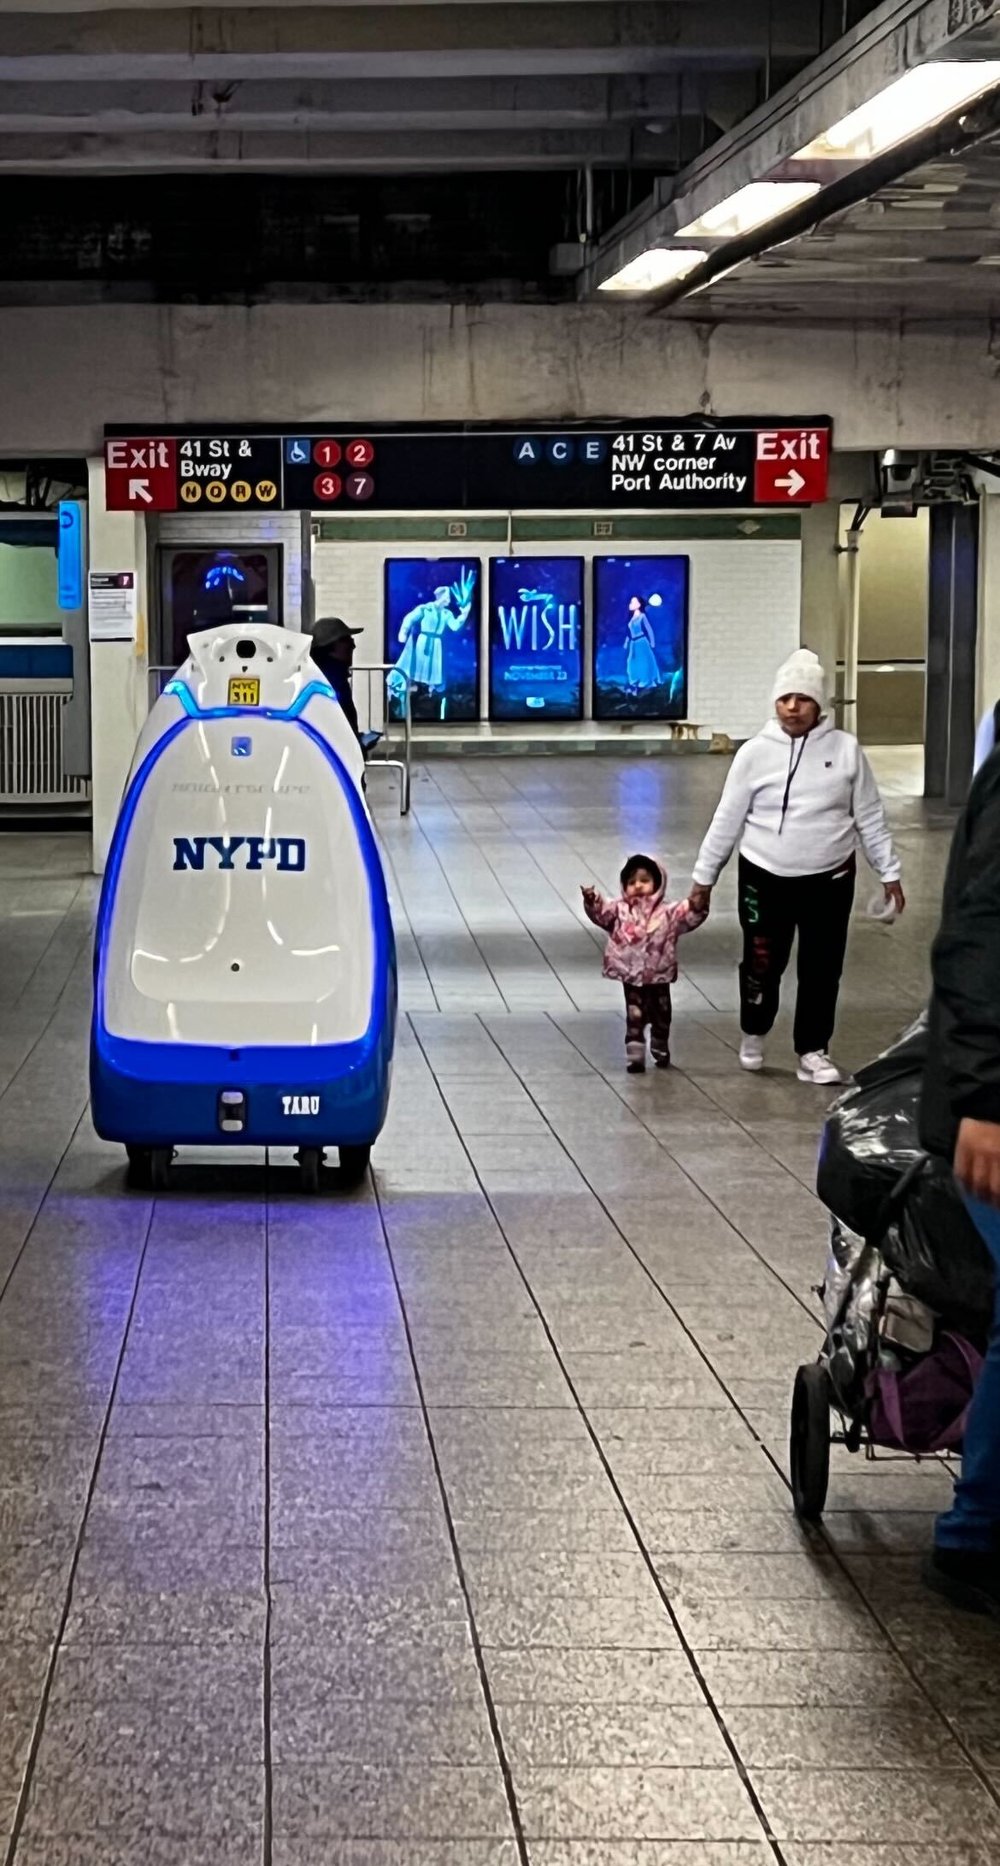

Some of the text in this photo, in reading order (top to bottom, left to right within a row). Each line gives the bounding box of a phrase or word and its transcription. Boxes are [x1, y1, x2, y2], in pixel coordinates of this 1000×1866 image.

[180, 440, 252, 457] 41 St &
[518, 441, 600, 459] A C E
[612, 433, 737, 451] 41 St & 7 Av
[756, 432, 821, 461] Exit
[107, 441, 169, 468] Exit
[322, 445, 366, 462] 1 2
[611, 454, 717, 471] NW corner
[181, 460, 232, 479] Bway
[322, 477, 367, 496] 3 7
[611, 472, 747, 492] Port Authority
[185, 485, 197, 499] N
[235, 484, 246, 498] R
[259, 484, 273, 498] W
[498, 603, 577, 650] WISH
[232, 682, 256, 691] NYC
[234, 692, 255, 702] 311
[172, 836, 306, 872] NYPD
